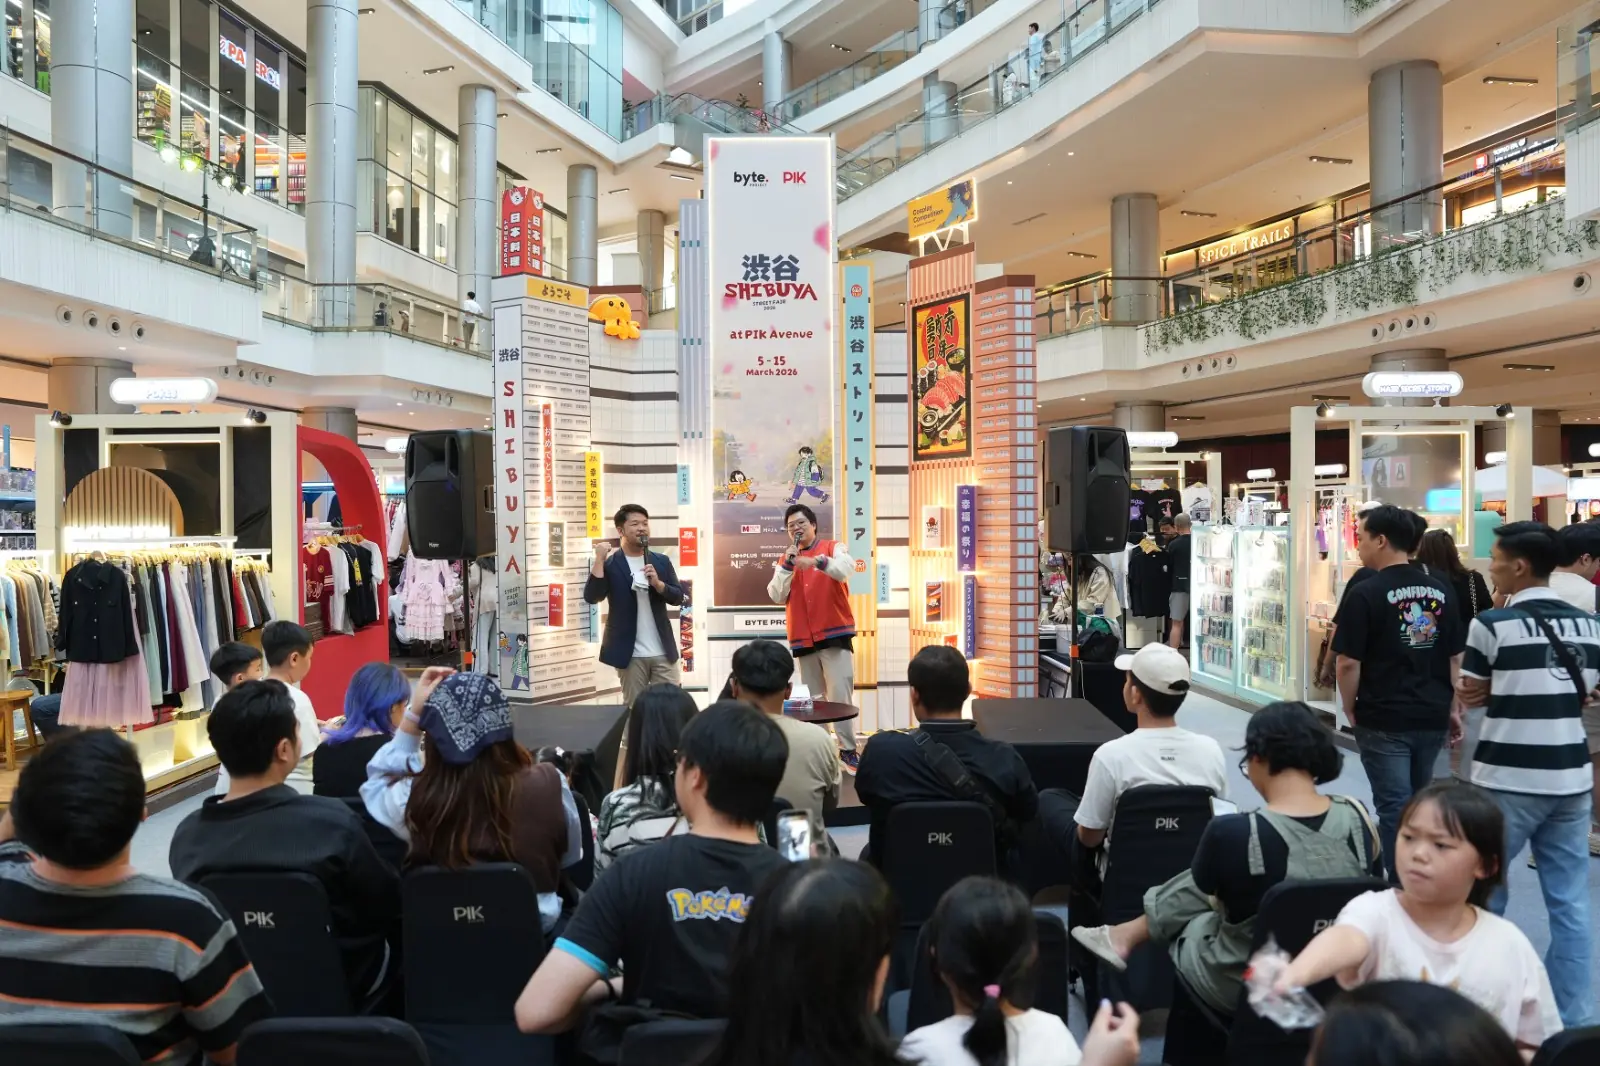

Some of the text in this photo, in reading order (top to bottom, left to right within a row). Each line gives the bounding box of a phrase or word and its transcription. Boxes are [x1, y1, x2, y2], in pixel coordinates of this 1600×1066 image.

[733, 171, 807, 187] byte. PIK
[1200, 225, 1291, 263] SPICE TRAILS
[741, 254, 800, 282] 渋谷
[541, 284, 572, 301] ようこそ
[724, 282, 818, 301] SHIBUYA
[730, 329, 813, 339] at PIK Avenue
[499, 347, 520, 362] 渋谷
[757, 356, 764, 366] 5
[774, 356, 786, 366] 15
[776, 368, 798, 376] 2026
[850, 315, 866, 541] 渋谷ストリートフェア
[503, 381, 521, 574] SHIBUYA
[1387, 585, 1446, 605] CONFIDENT
[1155, 817, 1179, 829] PIK
[928, 832, 953, 844] PIK
[244, 911, 275, 926] PIK
[453, 905, 484, 921] PIK
